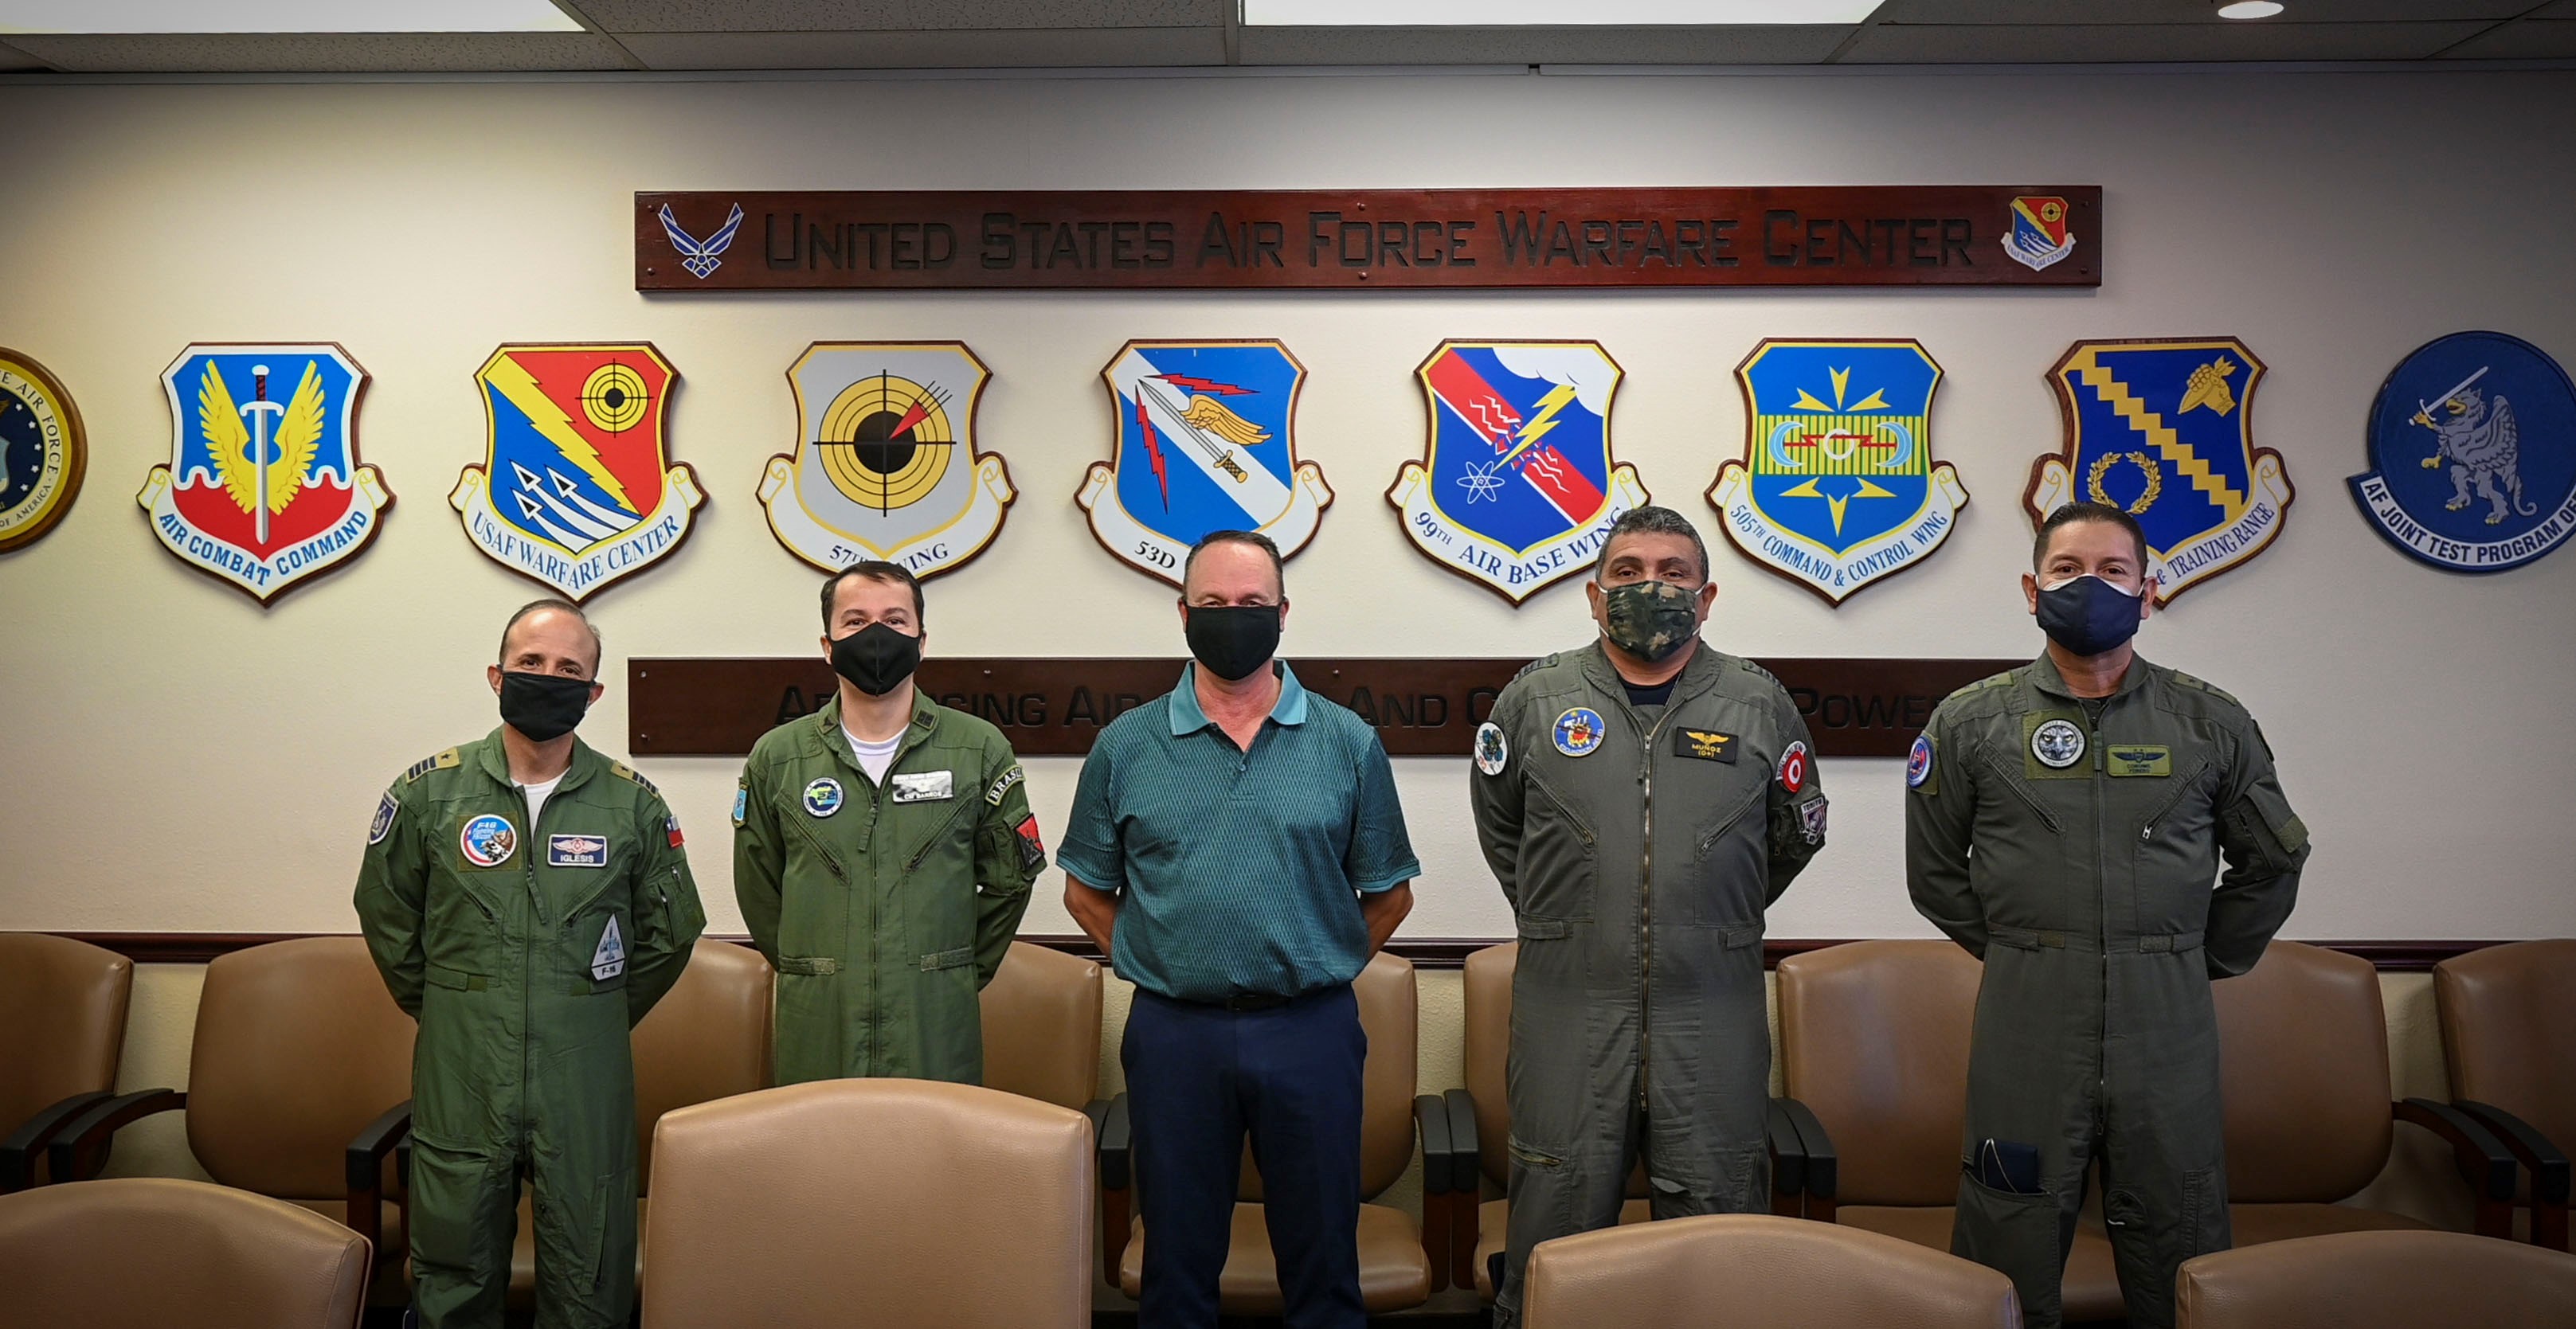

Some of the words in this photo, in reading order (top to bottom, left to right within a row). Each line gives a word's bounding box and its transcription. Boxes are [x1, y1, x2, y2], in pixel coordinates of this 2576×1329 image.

[765, 213, 953, 270] UNITED
[981, 213, 1175, 270] STATES
[1196, 211, 1284, 268] AIR
[1308, 210, 1476, 268] FORCE
[1494, 209, 1739, 268] WARFARE
[1763, 209, 1972, 268] CENTER
[16, 383, 44, 410] AIR
[42, 415, 61, 474] FORCE
[16, 484, 52, 521] AMERICA
[2364, 481, 2389, 503] AF
[2380, 507, 2428, 547] JOINT
[2429, 536, 2472, 563] TEST
[2477, 519, 2564, 563] PROGRAM
[159, 513, 188, 545] AIR
[188, 535, 271, 586] COMBAT
[276, 510, 367, 576] COMMAND
[473, 510, 516, 556] USAF
[519, 540, 604, 589] WARFARE
[607, 514, 679, 570] CENTER
[1134, 541, 1176, 569] 53D
[1415, 511, 1454, 545] 99TH
[1458, 545, 1501, 576] AIR
[1507, 547, 1566, 584] BASE
[1730, 504, 1767, 539] 505TH
[1763, 534, 1833, 581] COMMAND
[1834, 569, 1846, 587] &
[1847, 540, 1915, 581] CONTROL
[1911, 510, 1948, 545] WING
[2167, 537, 2238, 579] TRAINING
[2236, 502, 2275, 545] RANGE
[1349, 686, 1448, 728] AND
[1787, 688, 1945, 729] POWE
[990, 768, 1023, 800] BRASIL
